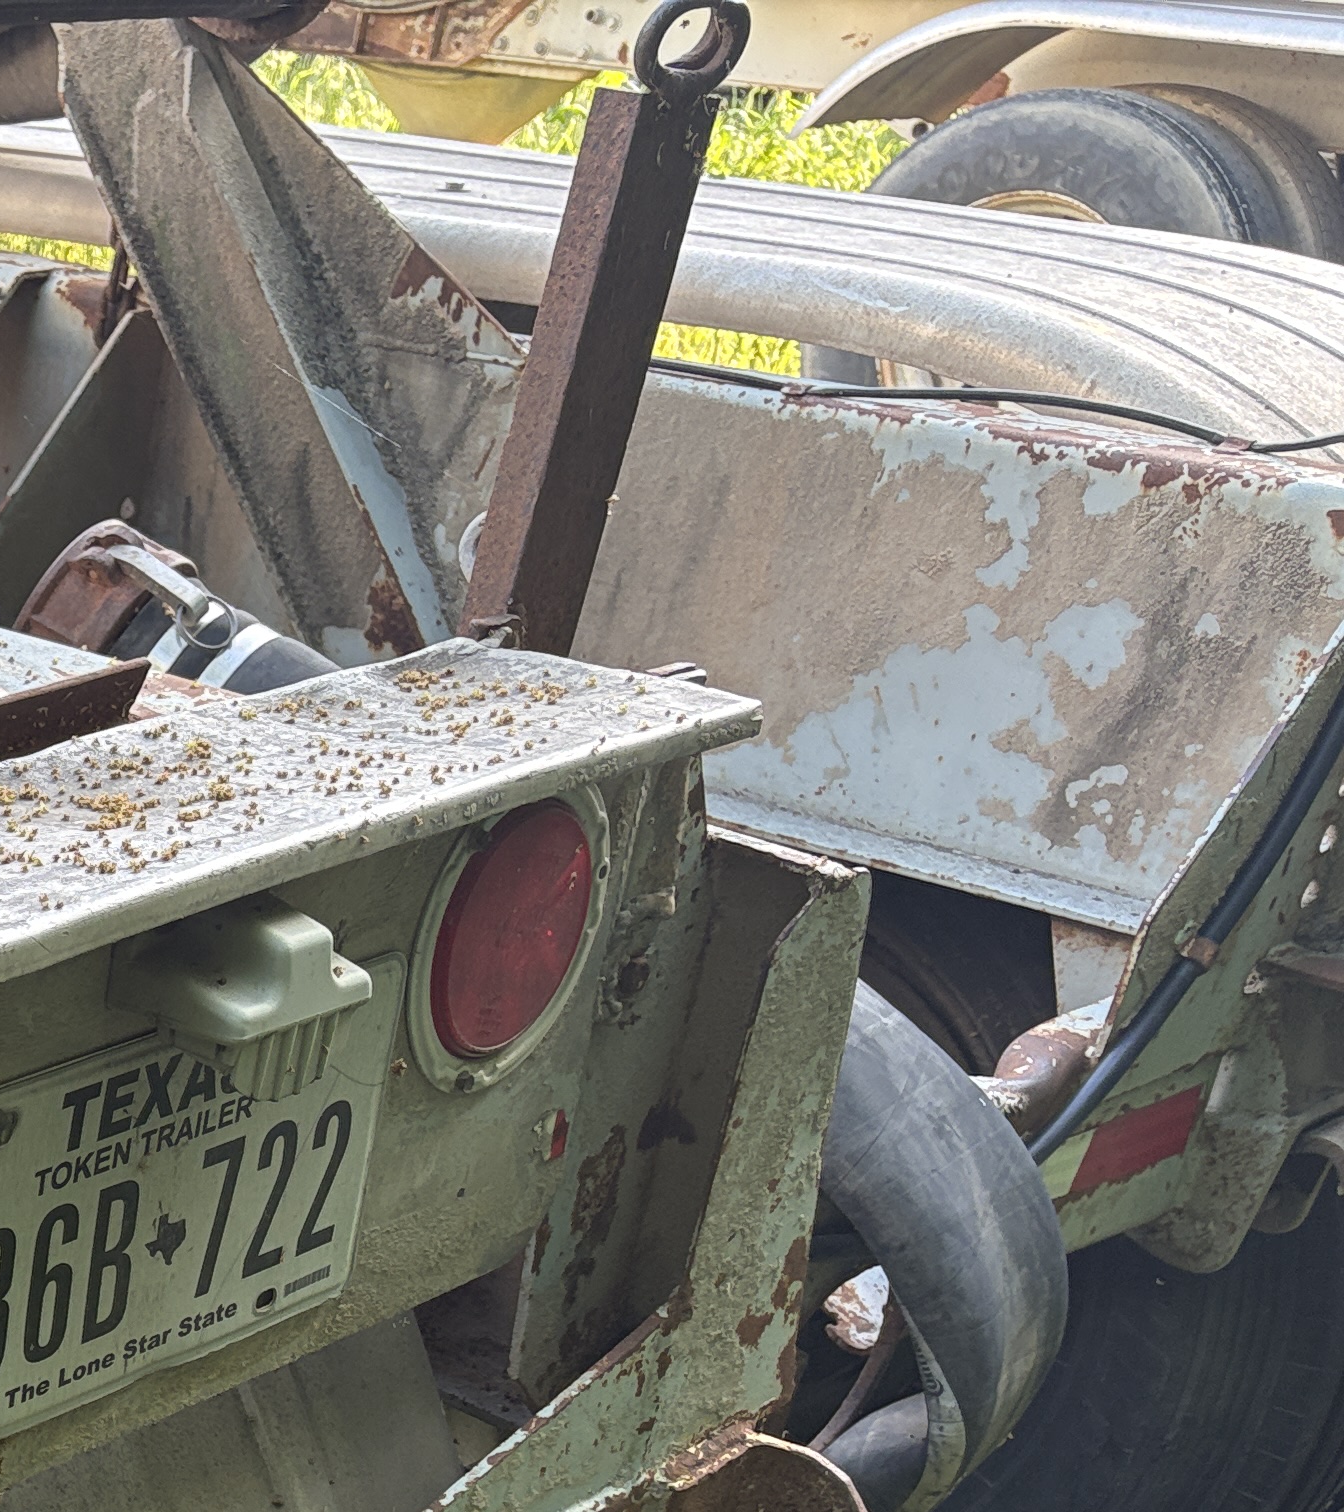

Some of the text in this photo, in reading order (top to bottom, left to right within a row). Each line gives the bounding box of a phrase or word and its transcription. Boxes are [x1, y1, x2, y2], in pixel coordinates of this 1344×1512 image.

[34, 1097, 253, 1197] TOKEN TRAILER
[193, 1099, 353, 1299] 722
[5, 1302, 239, 1410] The Lone Star State
